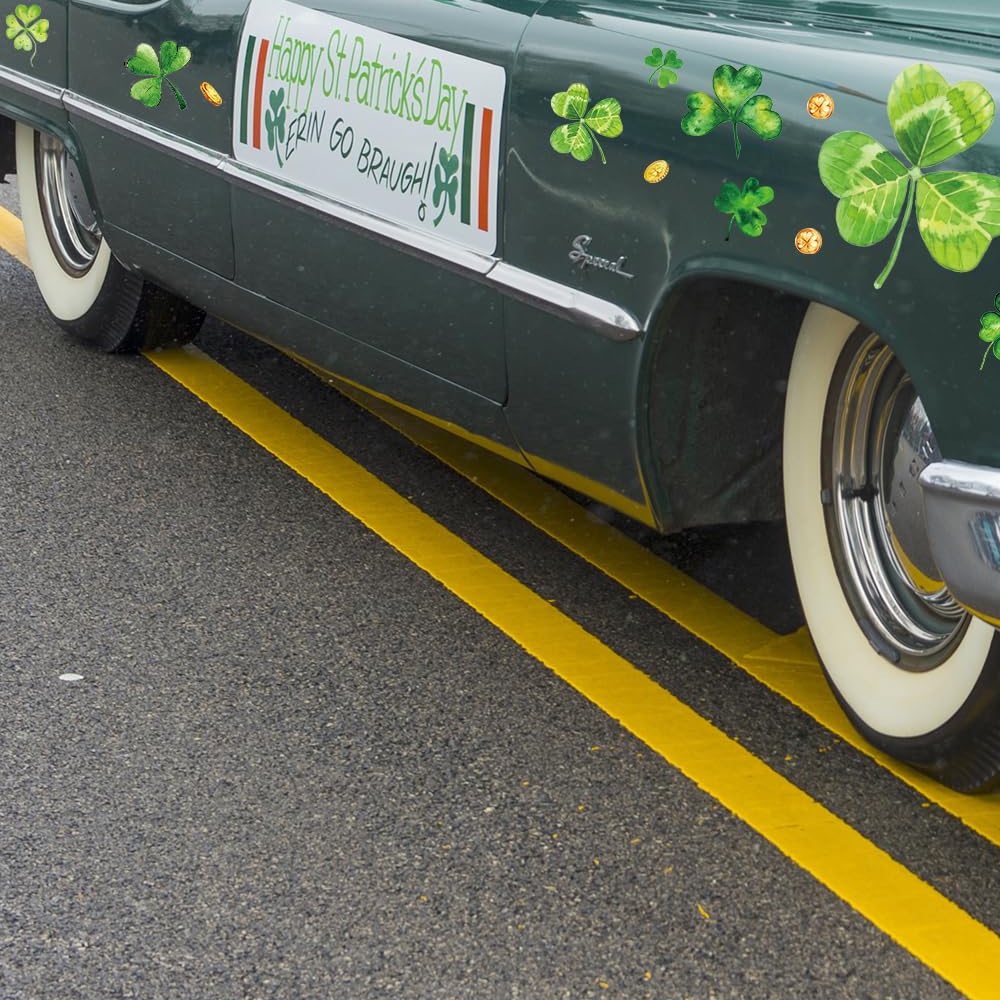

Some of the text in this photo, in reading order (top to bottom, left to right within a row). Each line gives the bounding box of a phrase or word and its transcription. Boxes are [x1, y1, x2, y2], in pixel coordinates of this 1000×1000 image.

[267, 16, 324, 113] Happy
[423, 58, 468, 158] Day
[285, 110, 437, 222] ERIN GO BRAUGH!
